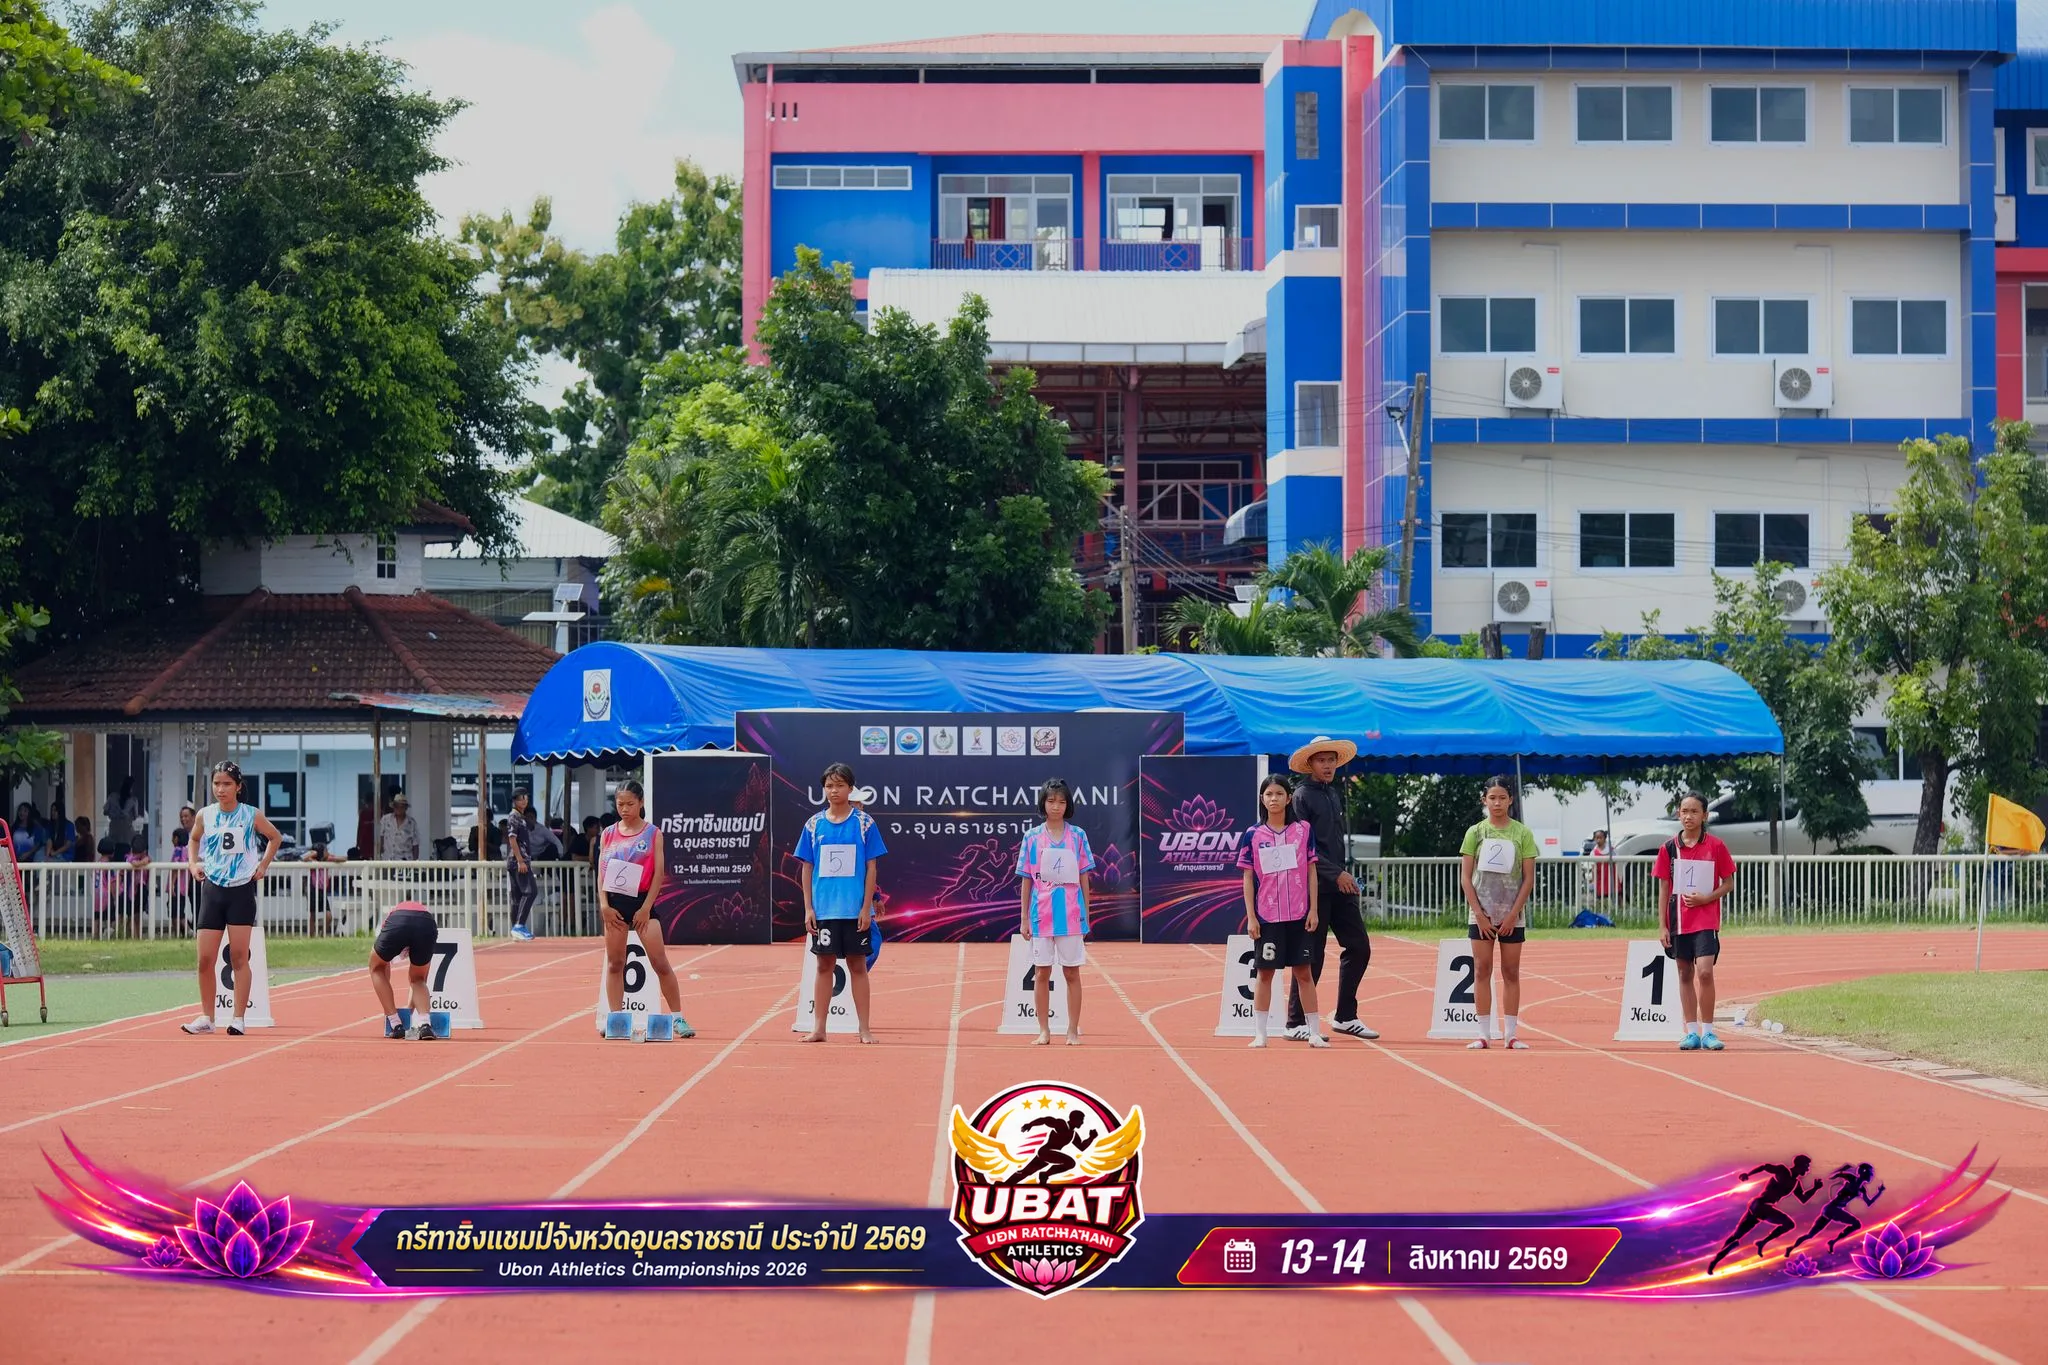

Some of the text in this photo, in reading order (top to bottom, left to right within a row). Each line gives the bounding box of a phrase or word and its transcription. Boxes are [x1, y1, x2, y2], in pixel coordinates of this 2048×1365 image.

[808, 785, 1118, 806] UON RATCHATANI
[1158, 832, 1243, 851] UBON
[829, 850, 845, 873] 5
[1160, 851, 1238, 862] ATHLETICS
[1272, 848, 1283, 868] 3
[1487, 843, 1504, 866] 2
[674, 864, 752, 874] 12-14 สิงหาคม 2569
[1053, 857, 1064, 874] 4
[614, 866, 628, 887] 6
[1685, 865, 1697, 888] 1
[1262, 942, 1277, 961] 6
[433, 943, 458, 992] 7
[623, 944, 646, 994] 6
[1448, 955, 1475, 1004] 2
[1641, 955, 1665, 1006] 1
[216, 994, 253, 1009] Neo
[430, 995, 458, 1010] elco
[621, 998, 646, 1011] elco
[1017, 1003, 1055, 1018] Neo
[1232, 1003, 1254, 1018] Nel
[1630, 1007, 1667, 1023] Nelco
